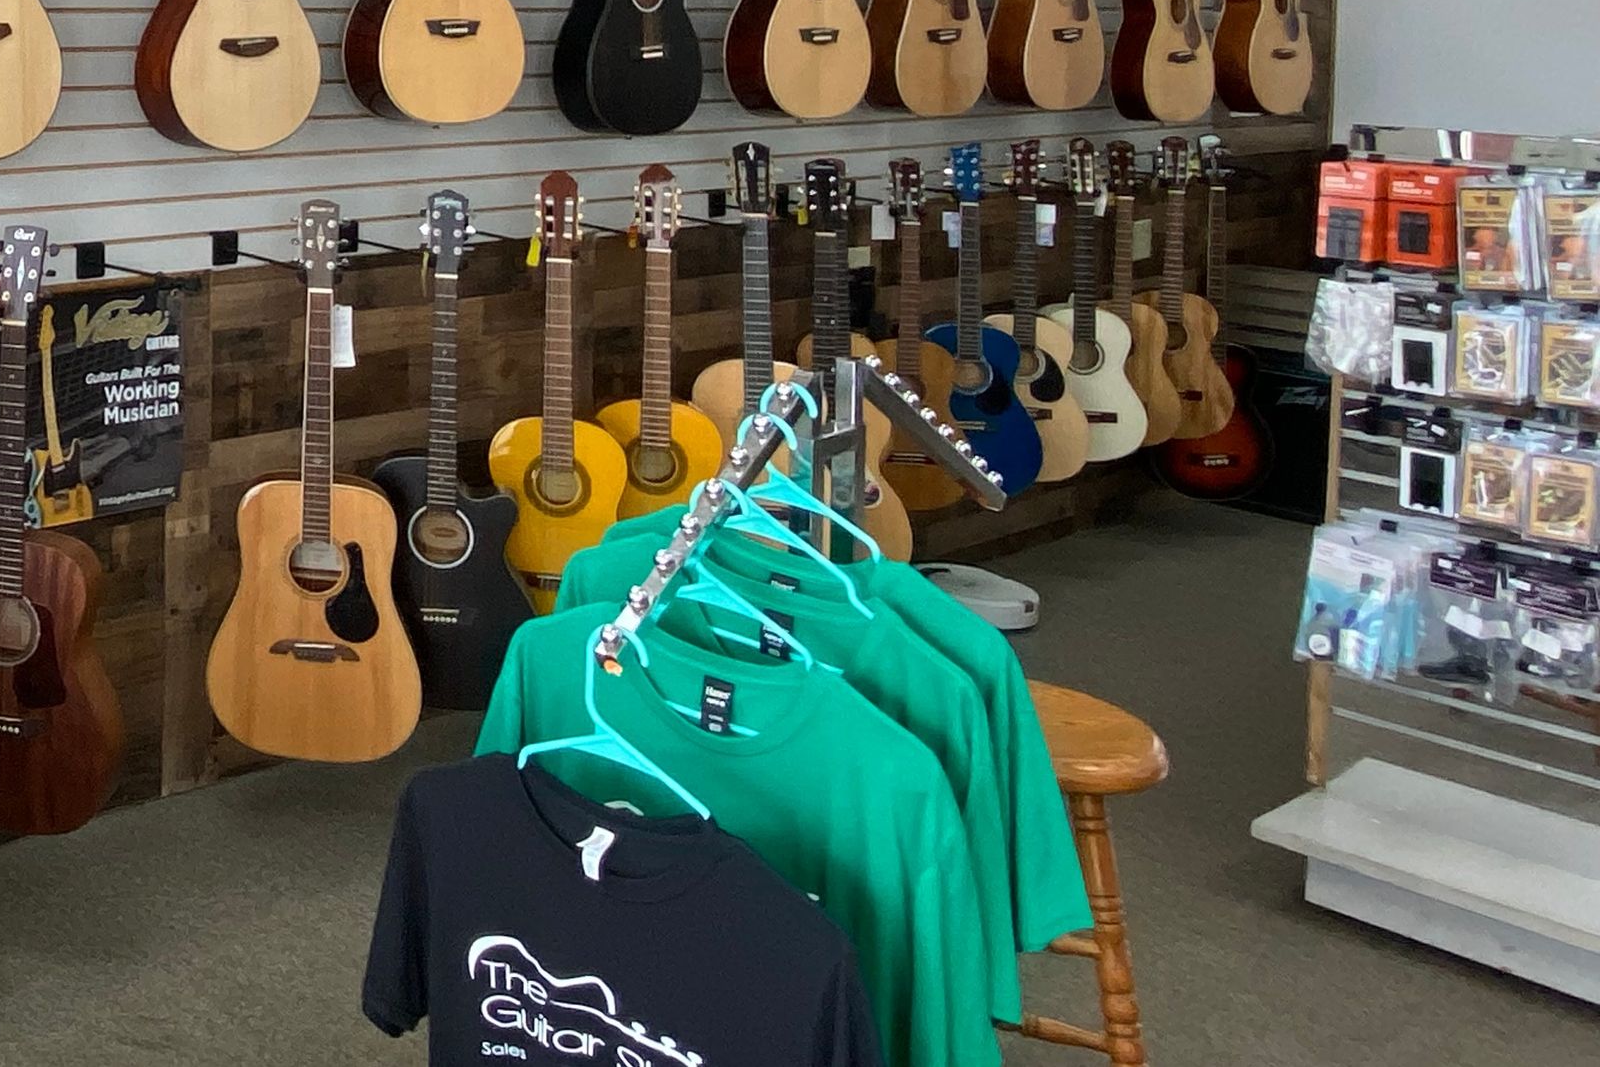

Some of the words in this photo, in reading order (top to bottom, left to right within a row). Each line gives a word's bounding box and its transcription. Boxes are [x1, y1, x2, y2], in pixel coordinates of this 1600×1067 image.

[85, 372, 119, 385] Guitars
[120, 367, 143, 381] Built
[144, 365, 162, 377] For
[163, 363, 180, 375] The
[104, 380, 180, 403] Working
[104, 400, 180, 425] Musician
[481, 959, 548, 1005] The
[481, 995, 606, 1057] Guitar
[481, 1041, 527, 1060] Sales
